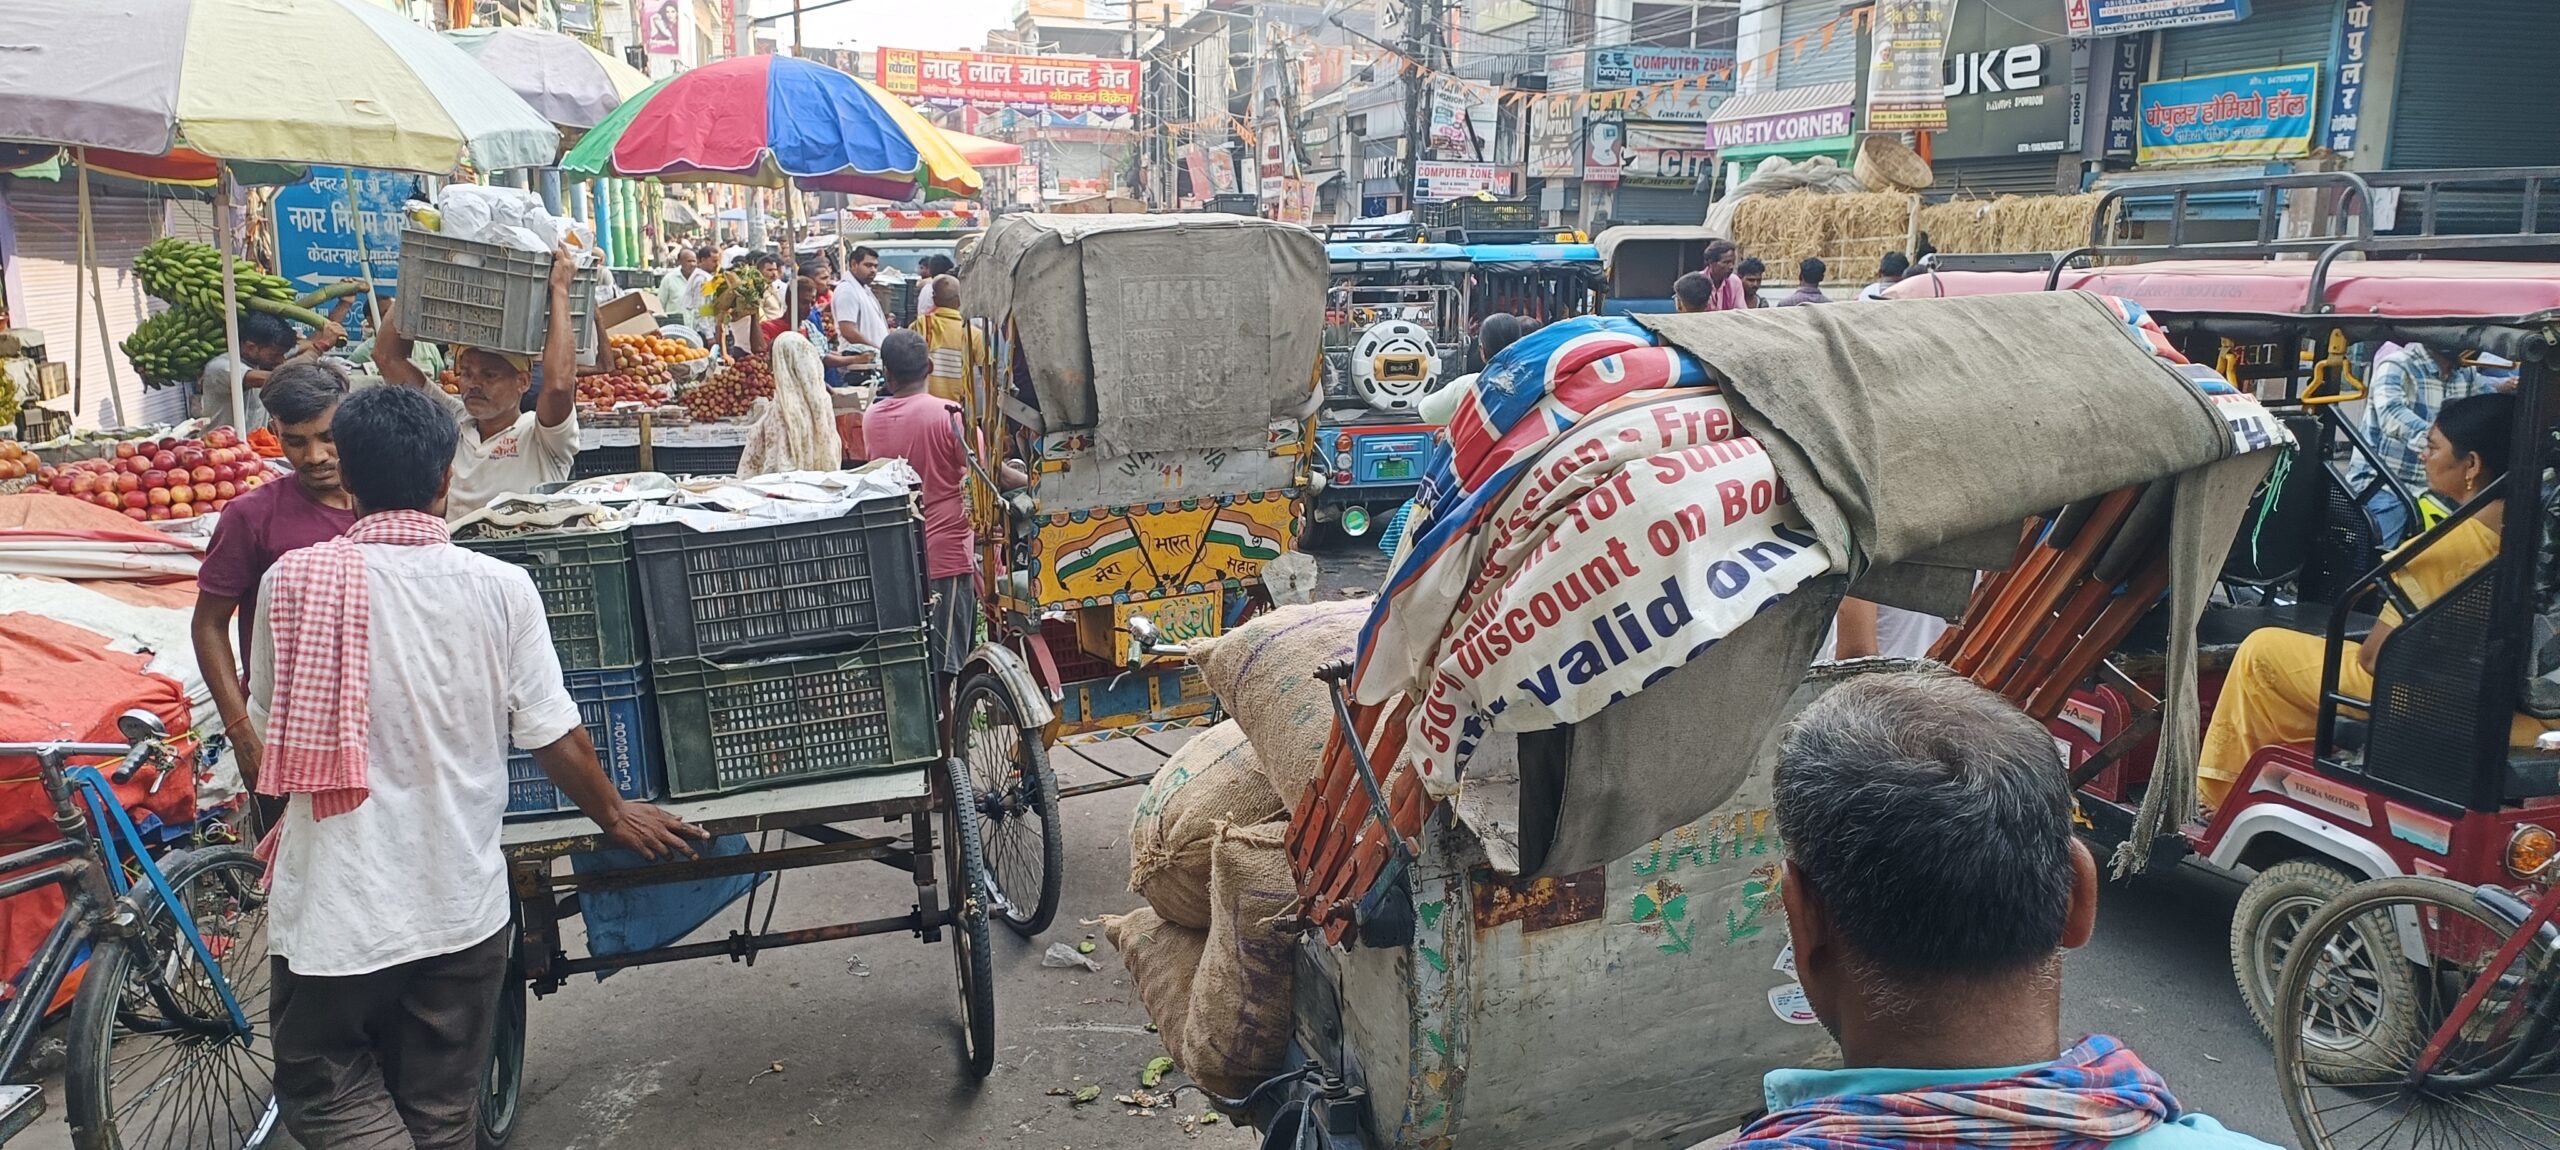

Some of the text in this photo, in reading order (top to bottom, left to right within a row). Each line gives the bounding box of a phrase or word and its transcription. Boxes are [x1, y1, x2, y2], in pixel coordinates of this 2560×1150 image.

[1097, 63, 1132, 90] जैन
[1599, 67, 1632, 77] brother
[1633, 54, 1734, 73] COMPUTER ZONE
[1590, 91, 1625, 109] CTY
[2202, 91, 2263, 125] होमियो
[2267, 88, 2308, 120] हॉल
[1546, 118, 1573, 136] OPTICAL
[1657, 109, 1703, 120] fastrack
[1713, 121, 1775, 146] VARIETY
[1775, 112, 1845, 140] CORNER
[1418, 166, 1493, 179] COMPUTER ZONE
[1660, 149, 1723, 177] CITY
[287, 207, 327, 233] नगर
[1565, 469, 1637, 535] for
[1647, 503, 1707, 558] on
[1154, 534, 1192, 557] भारत
[1518, 575, 1694, 706] valid
[2294, 782, 2360, 812] TERRA MOTORS
